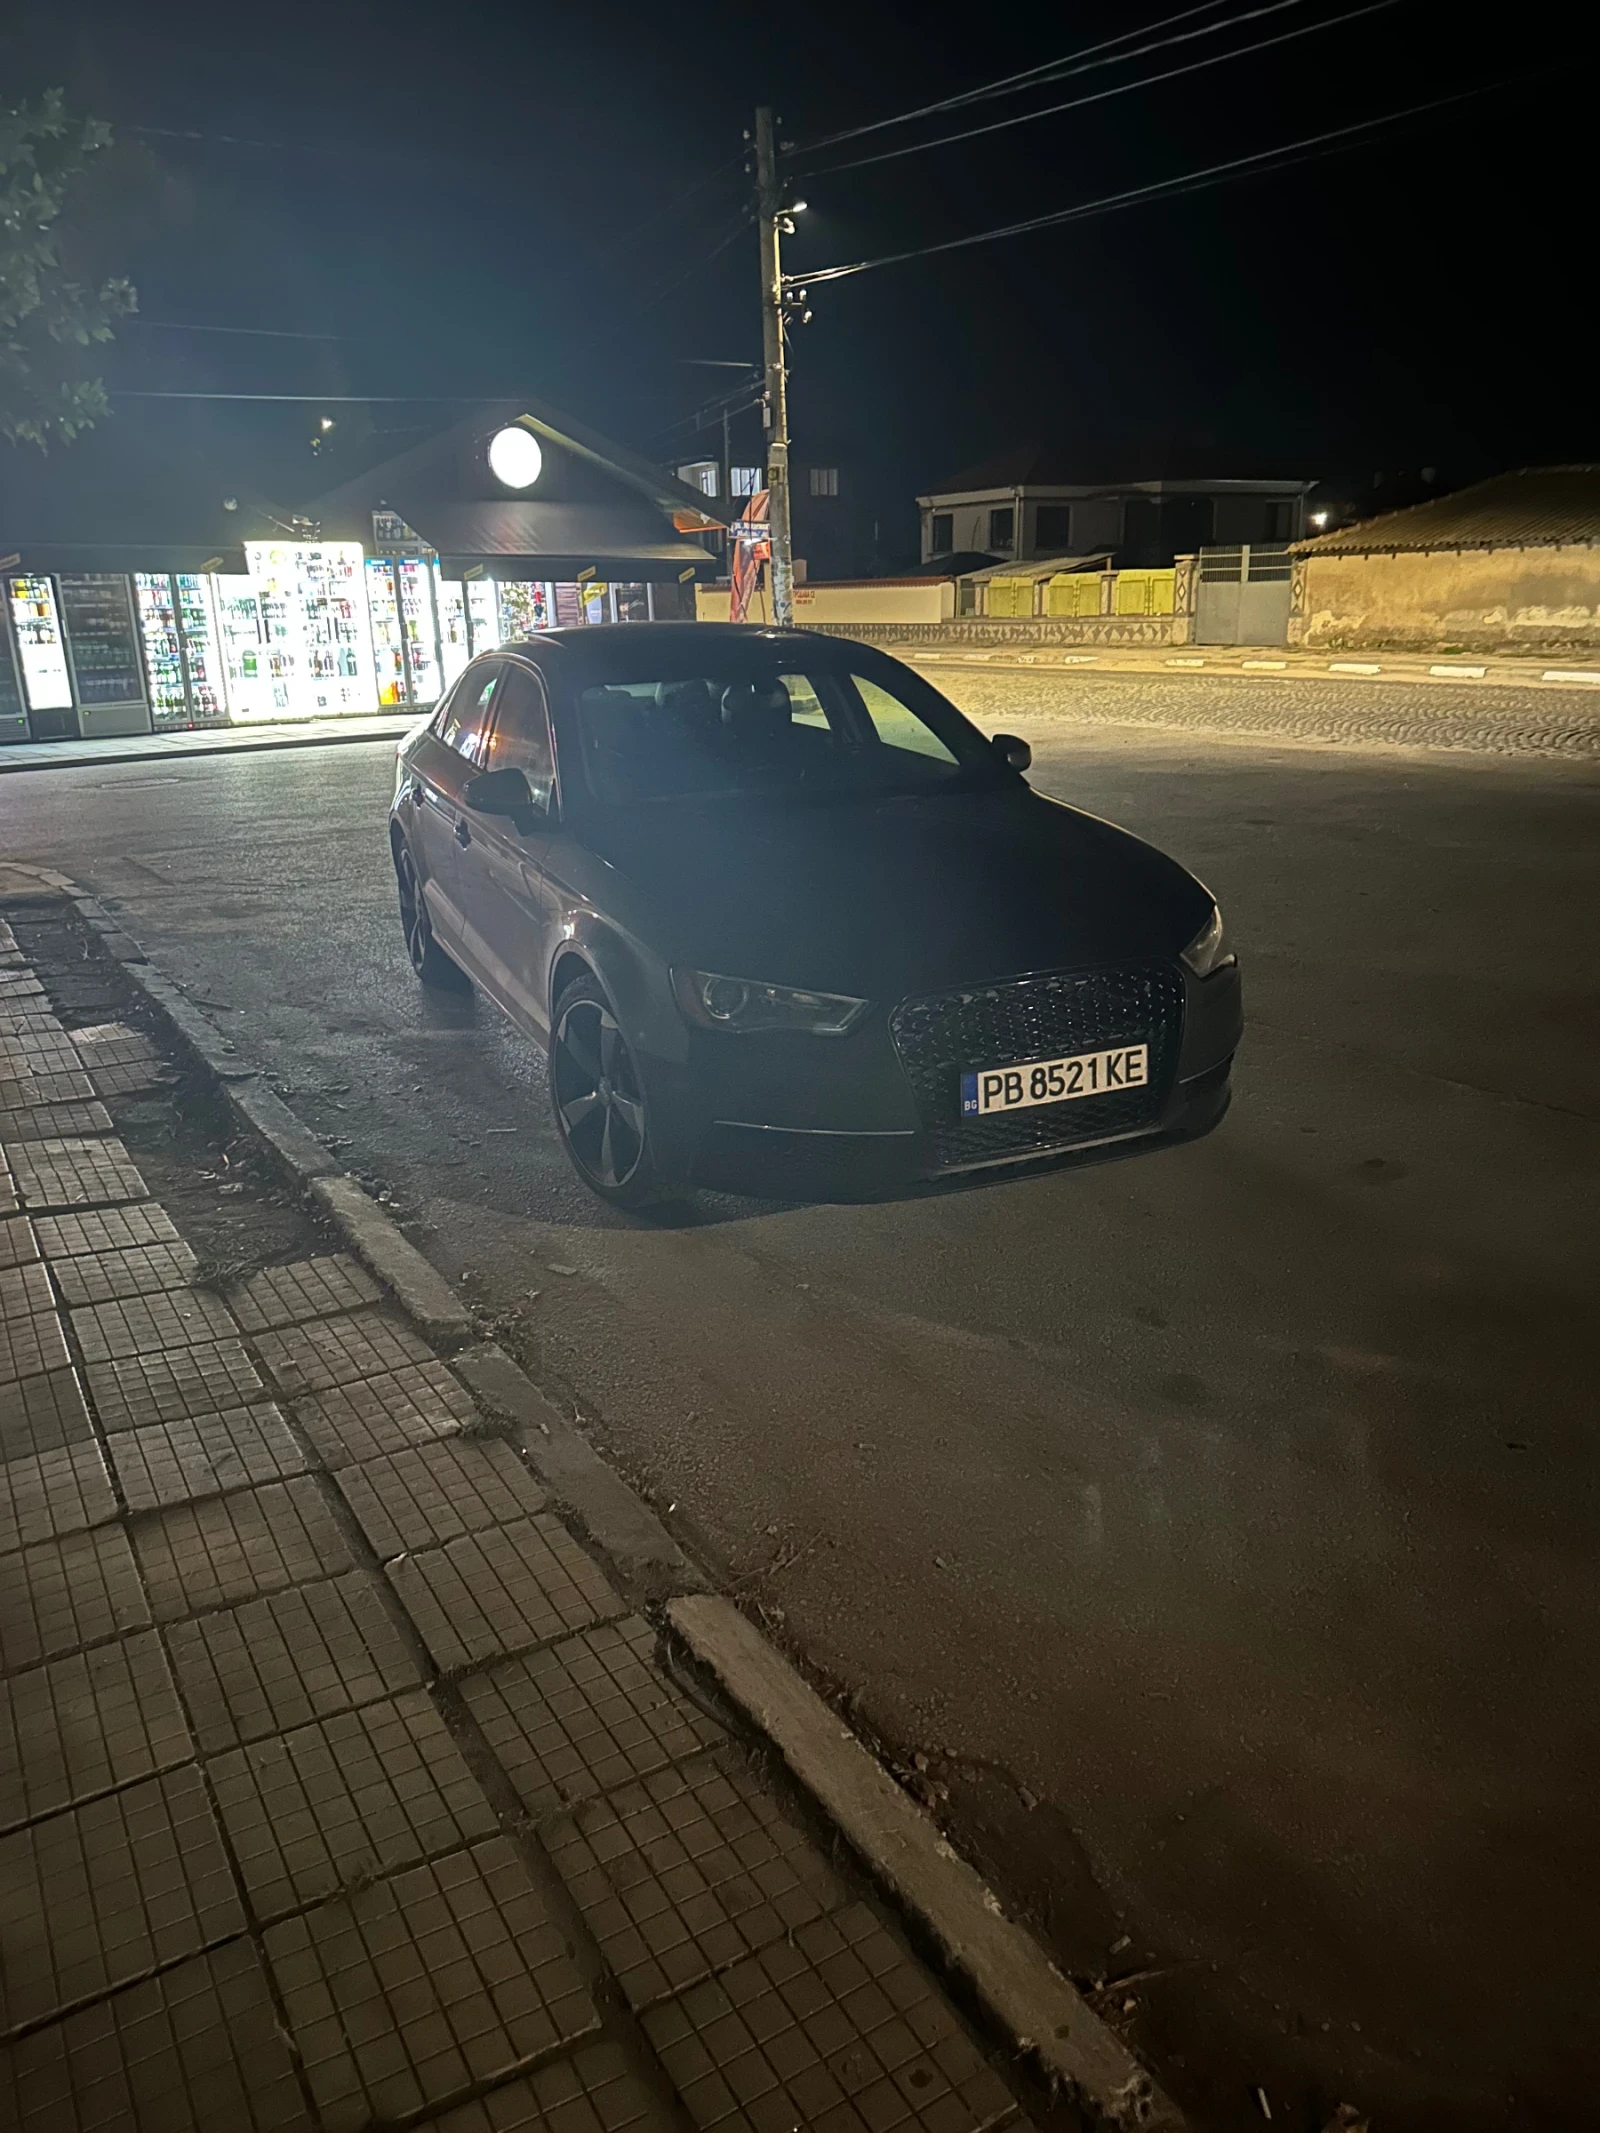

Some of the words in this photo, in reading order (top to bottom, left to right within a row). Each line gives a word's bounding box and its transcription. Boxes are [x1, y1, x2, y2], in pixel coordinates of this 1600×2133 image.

[984, 1072, 1023, 1108] PB
[1030, 1057, 1098, 1099] 8521
[1106, 1049, 1143, 1087] KE
[964, 1099, 978, 1111] BG
